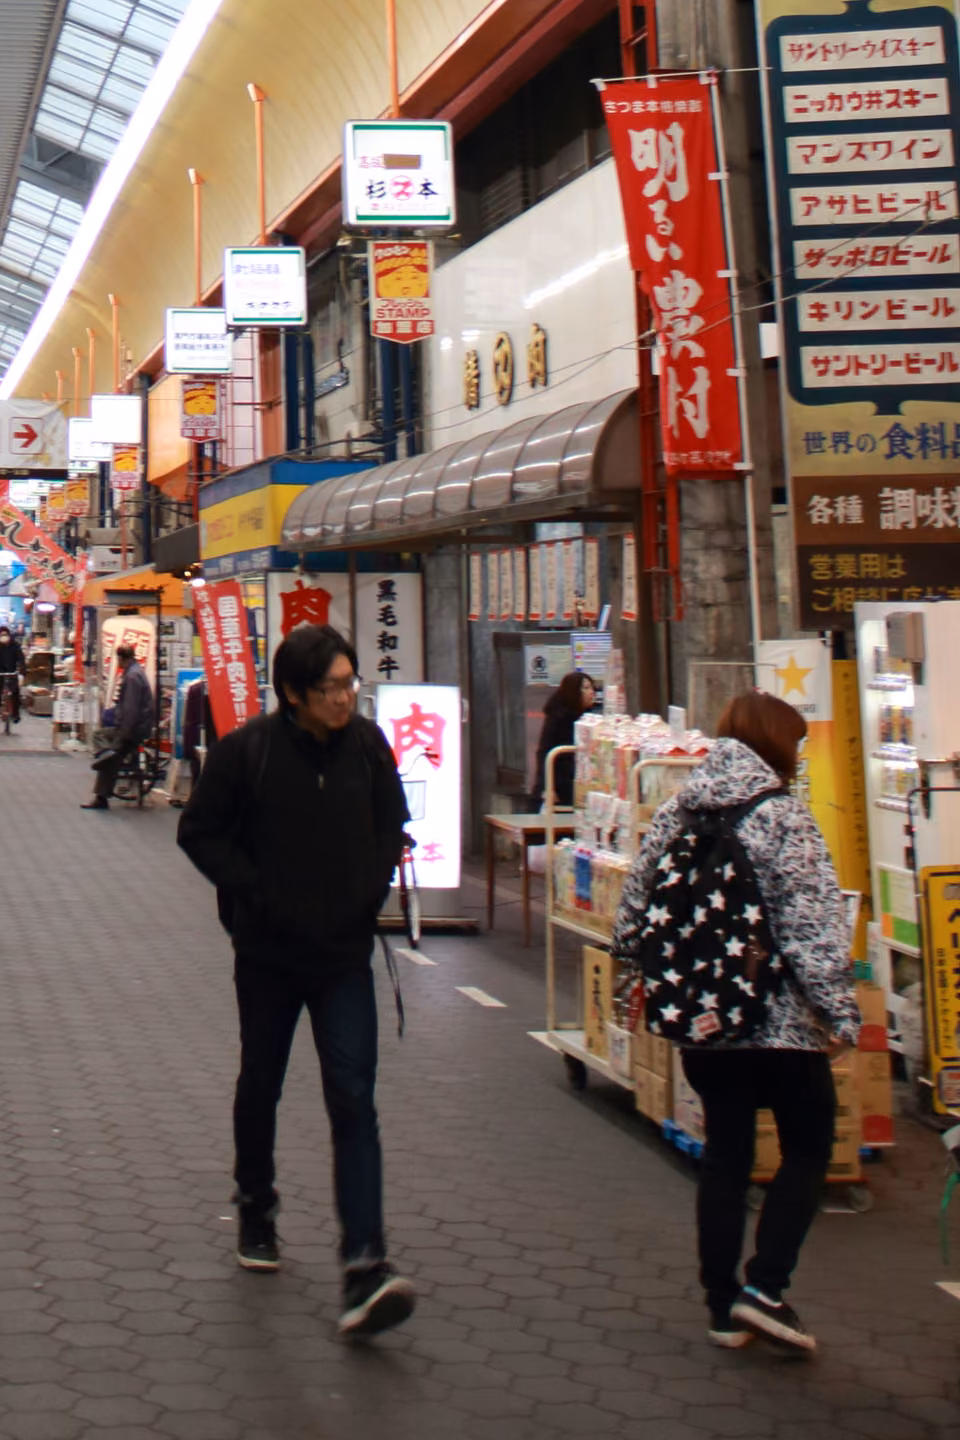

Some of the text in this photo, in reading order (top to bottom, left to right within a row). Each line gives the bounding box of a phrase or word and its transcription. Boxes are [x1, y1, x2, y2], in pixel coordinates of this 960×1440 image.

[800, 191, 948, 217] アサヒビール
[804, 244, 952, 268] サッポロビール
[376, 307, 431, 319] STAMP
[807, 297, 956, 322] キリンビール
[811, 351, 960, 377] サントリービール
[806, 486, 960, 530] 各種 調味
[807, 553, 908, 580] 営業用は
[376, 579, 400, 680] 黒毛和牛
[389, 702, 447, 770] 肉
